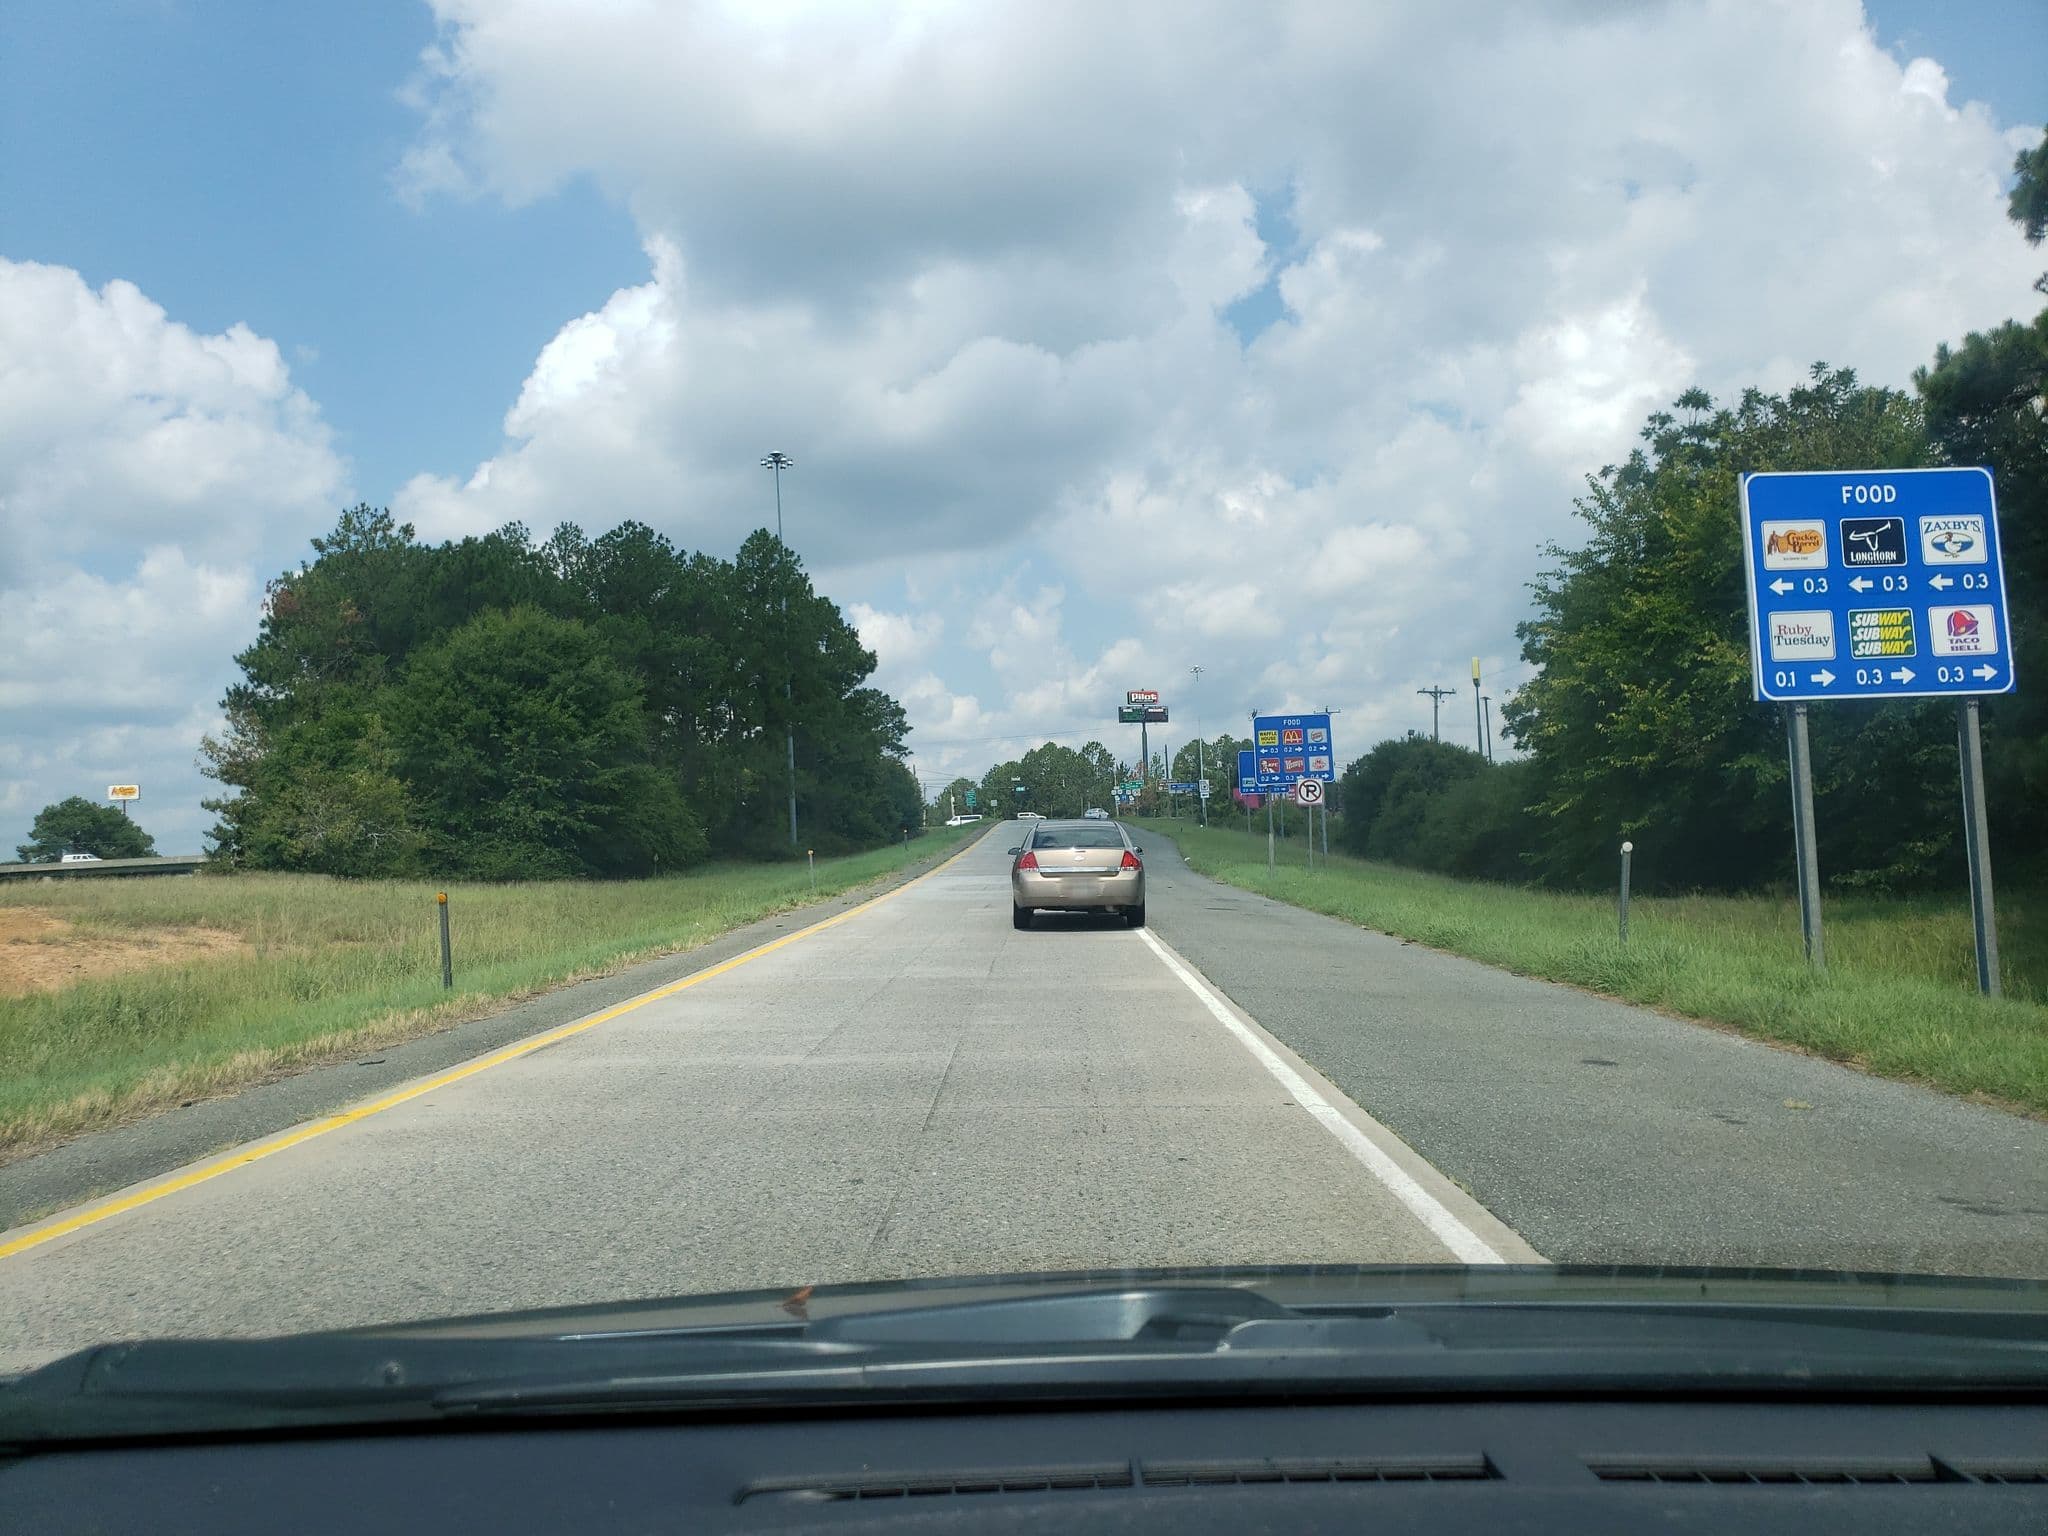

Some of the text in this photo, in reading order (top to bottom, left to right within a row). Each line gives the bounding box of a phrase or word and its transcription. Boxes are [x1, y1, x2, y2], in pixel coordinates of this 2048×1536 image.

[1841, 485, 1897, 504] FOOD
[1924, 520, 1982, 534] ZAXBY'S
[1787, 532, 1818, 546] Cracker
[1791, 539, 1820, 553] Barrel
[1850, 551, 1897, 562] LONGHORN
[1803, 578, 1829, 593] 0.3
[1882, 575, 1908, 591] 0.3
[1963, 573, 1989, 589] 0.3
[1852, 611, 1910, 626] SUBWAY
[1777, 624, 1812, 638] Ruby
[1853, 625, 1911, 640] SUBWAY
[1774, 634, 1830, 647] Tuesday
[1854, 640, 1913, 655] SUBWAY
[1948, 637, 1980, 645] TACO
[1950, 644, 1982, 652] BELL
[1775, 671, 1796, 687] 0.1
[1856, 669, 1883, 685] 0.3
[1938, 666, 1964, 682] 0.3
